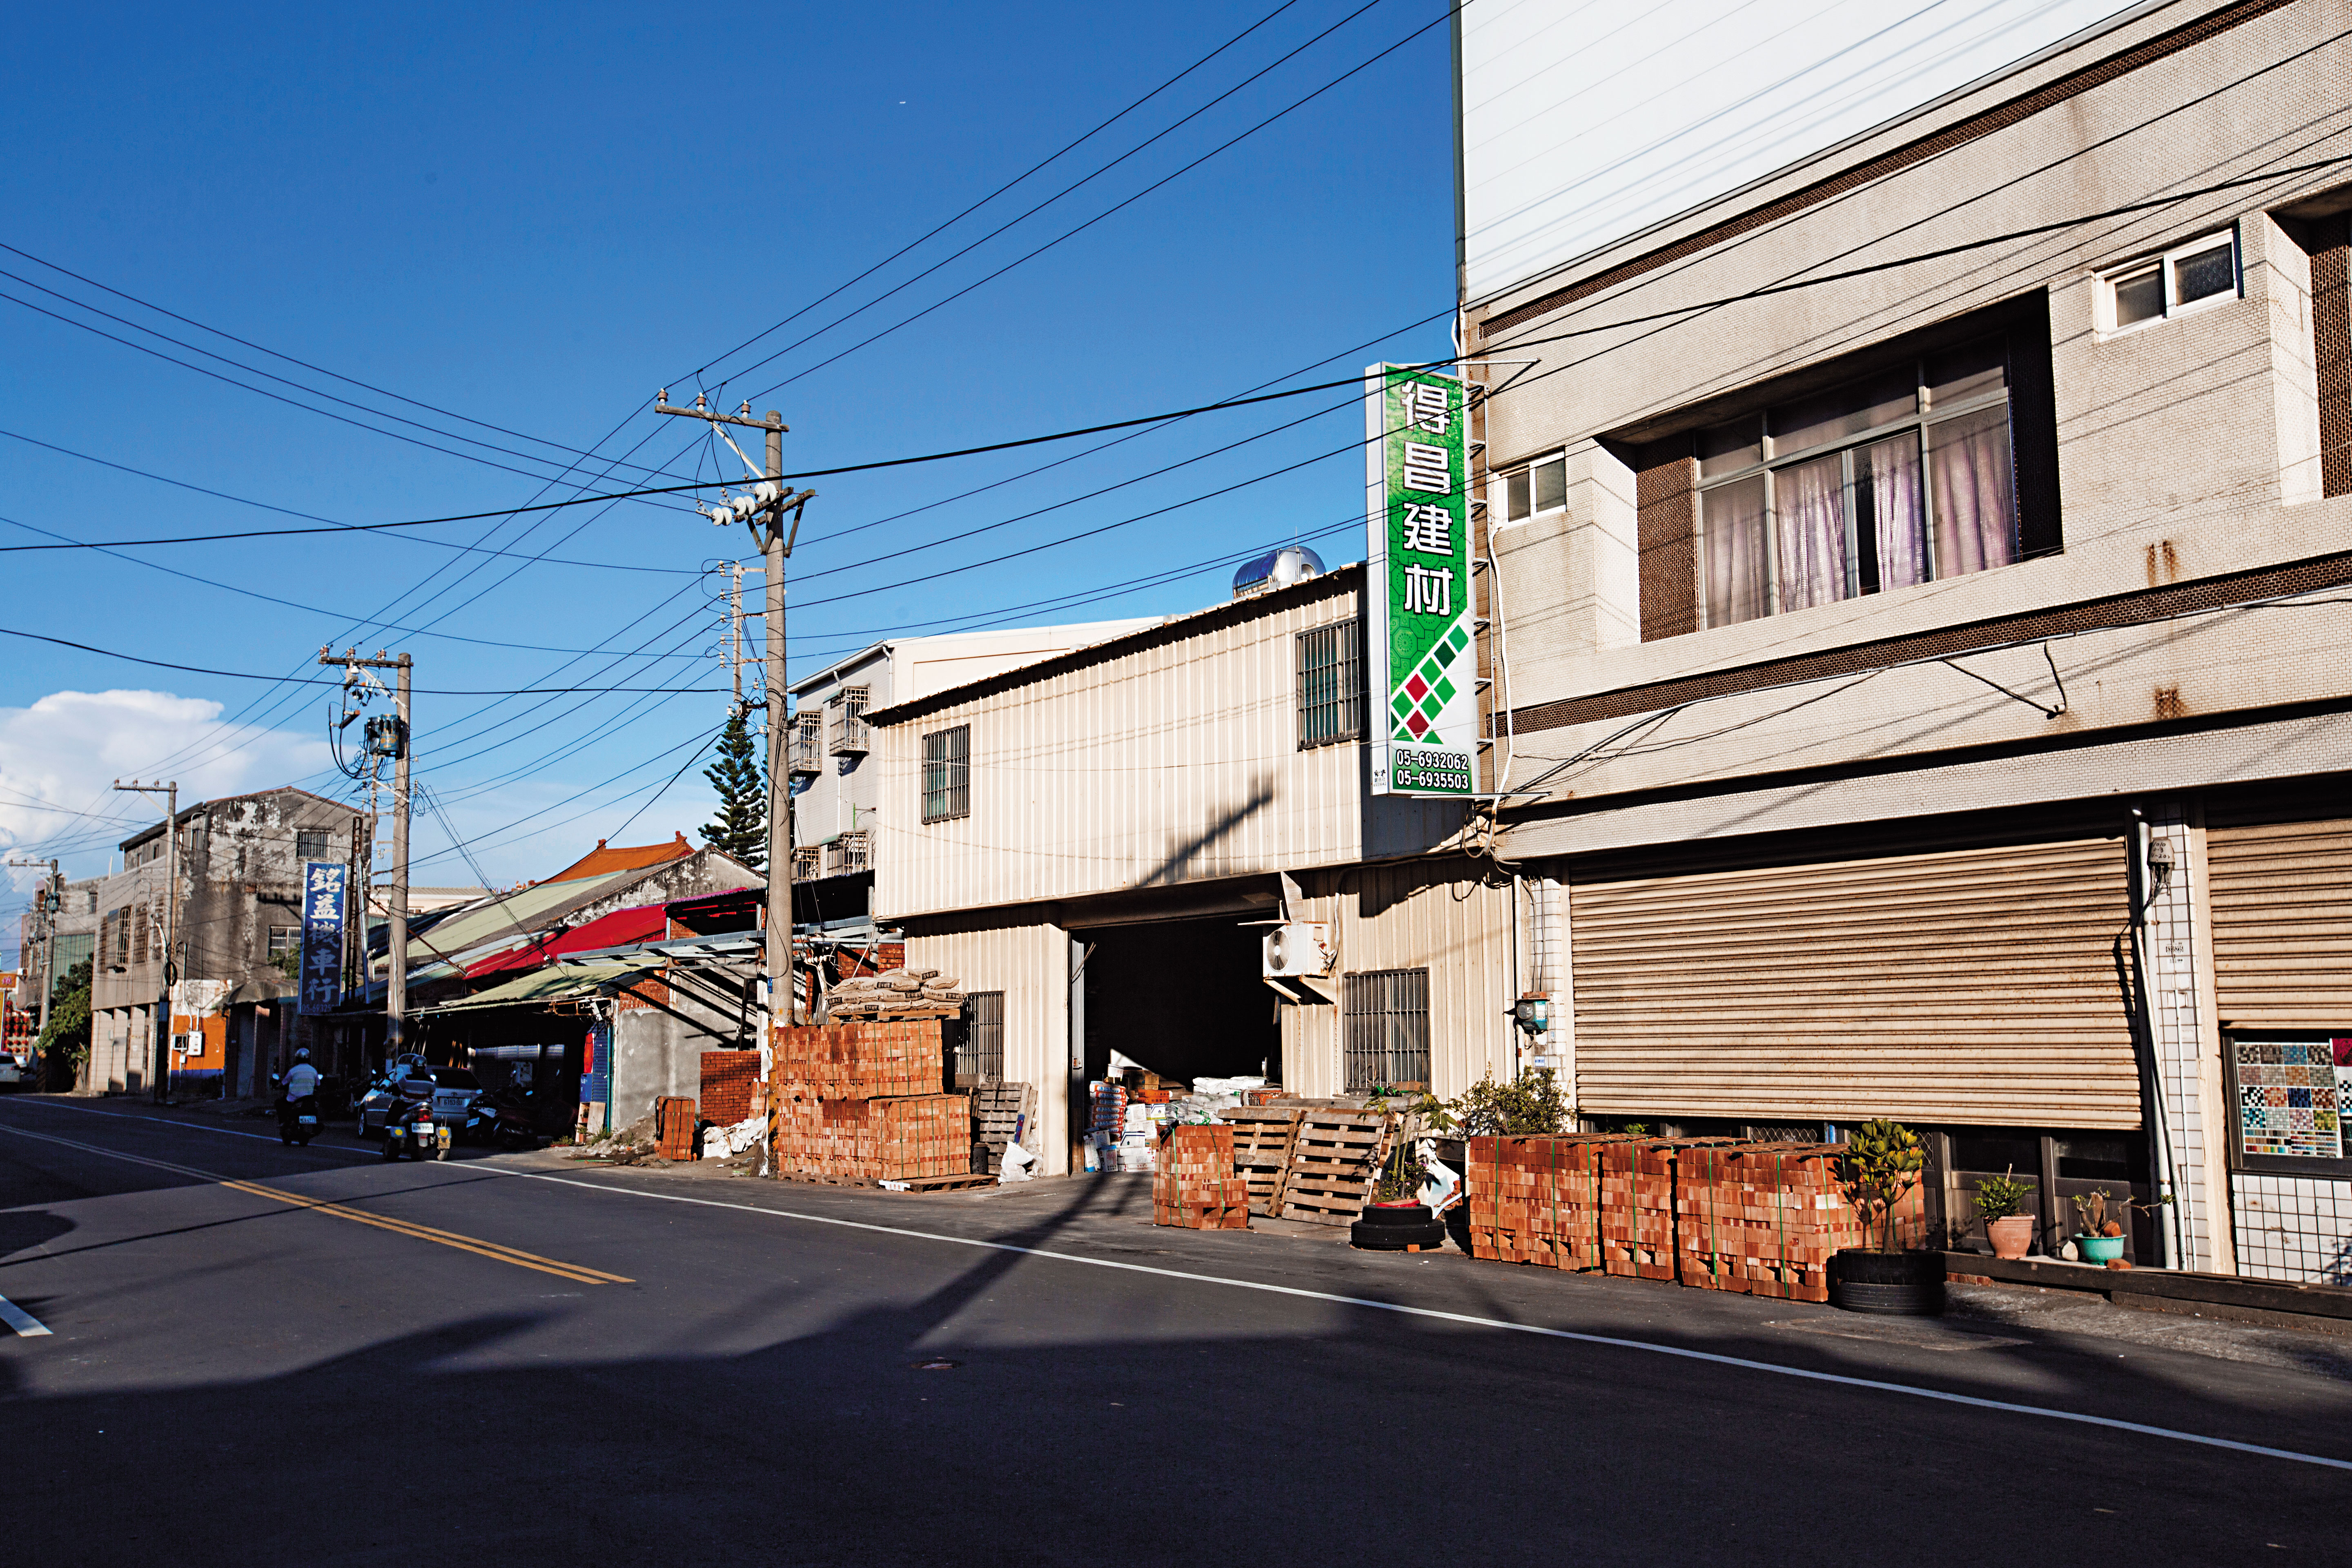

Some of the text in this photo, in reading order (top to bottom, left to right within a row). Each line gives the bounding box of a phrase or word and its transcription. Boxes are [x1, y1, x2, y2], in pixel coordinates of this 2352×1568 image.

[1401, 380, 1454, 616] 得昌建材
[1396, 749, 1468, 771] 05-6932062
[1396, 769, 1469, 789] 05-6935503
